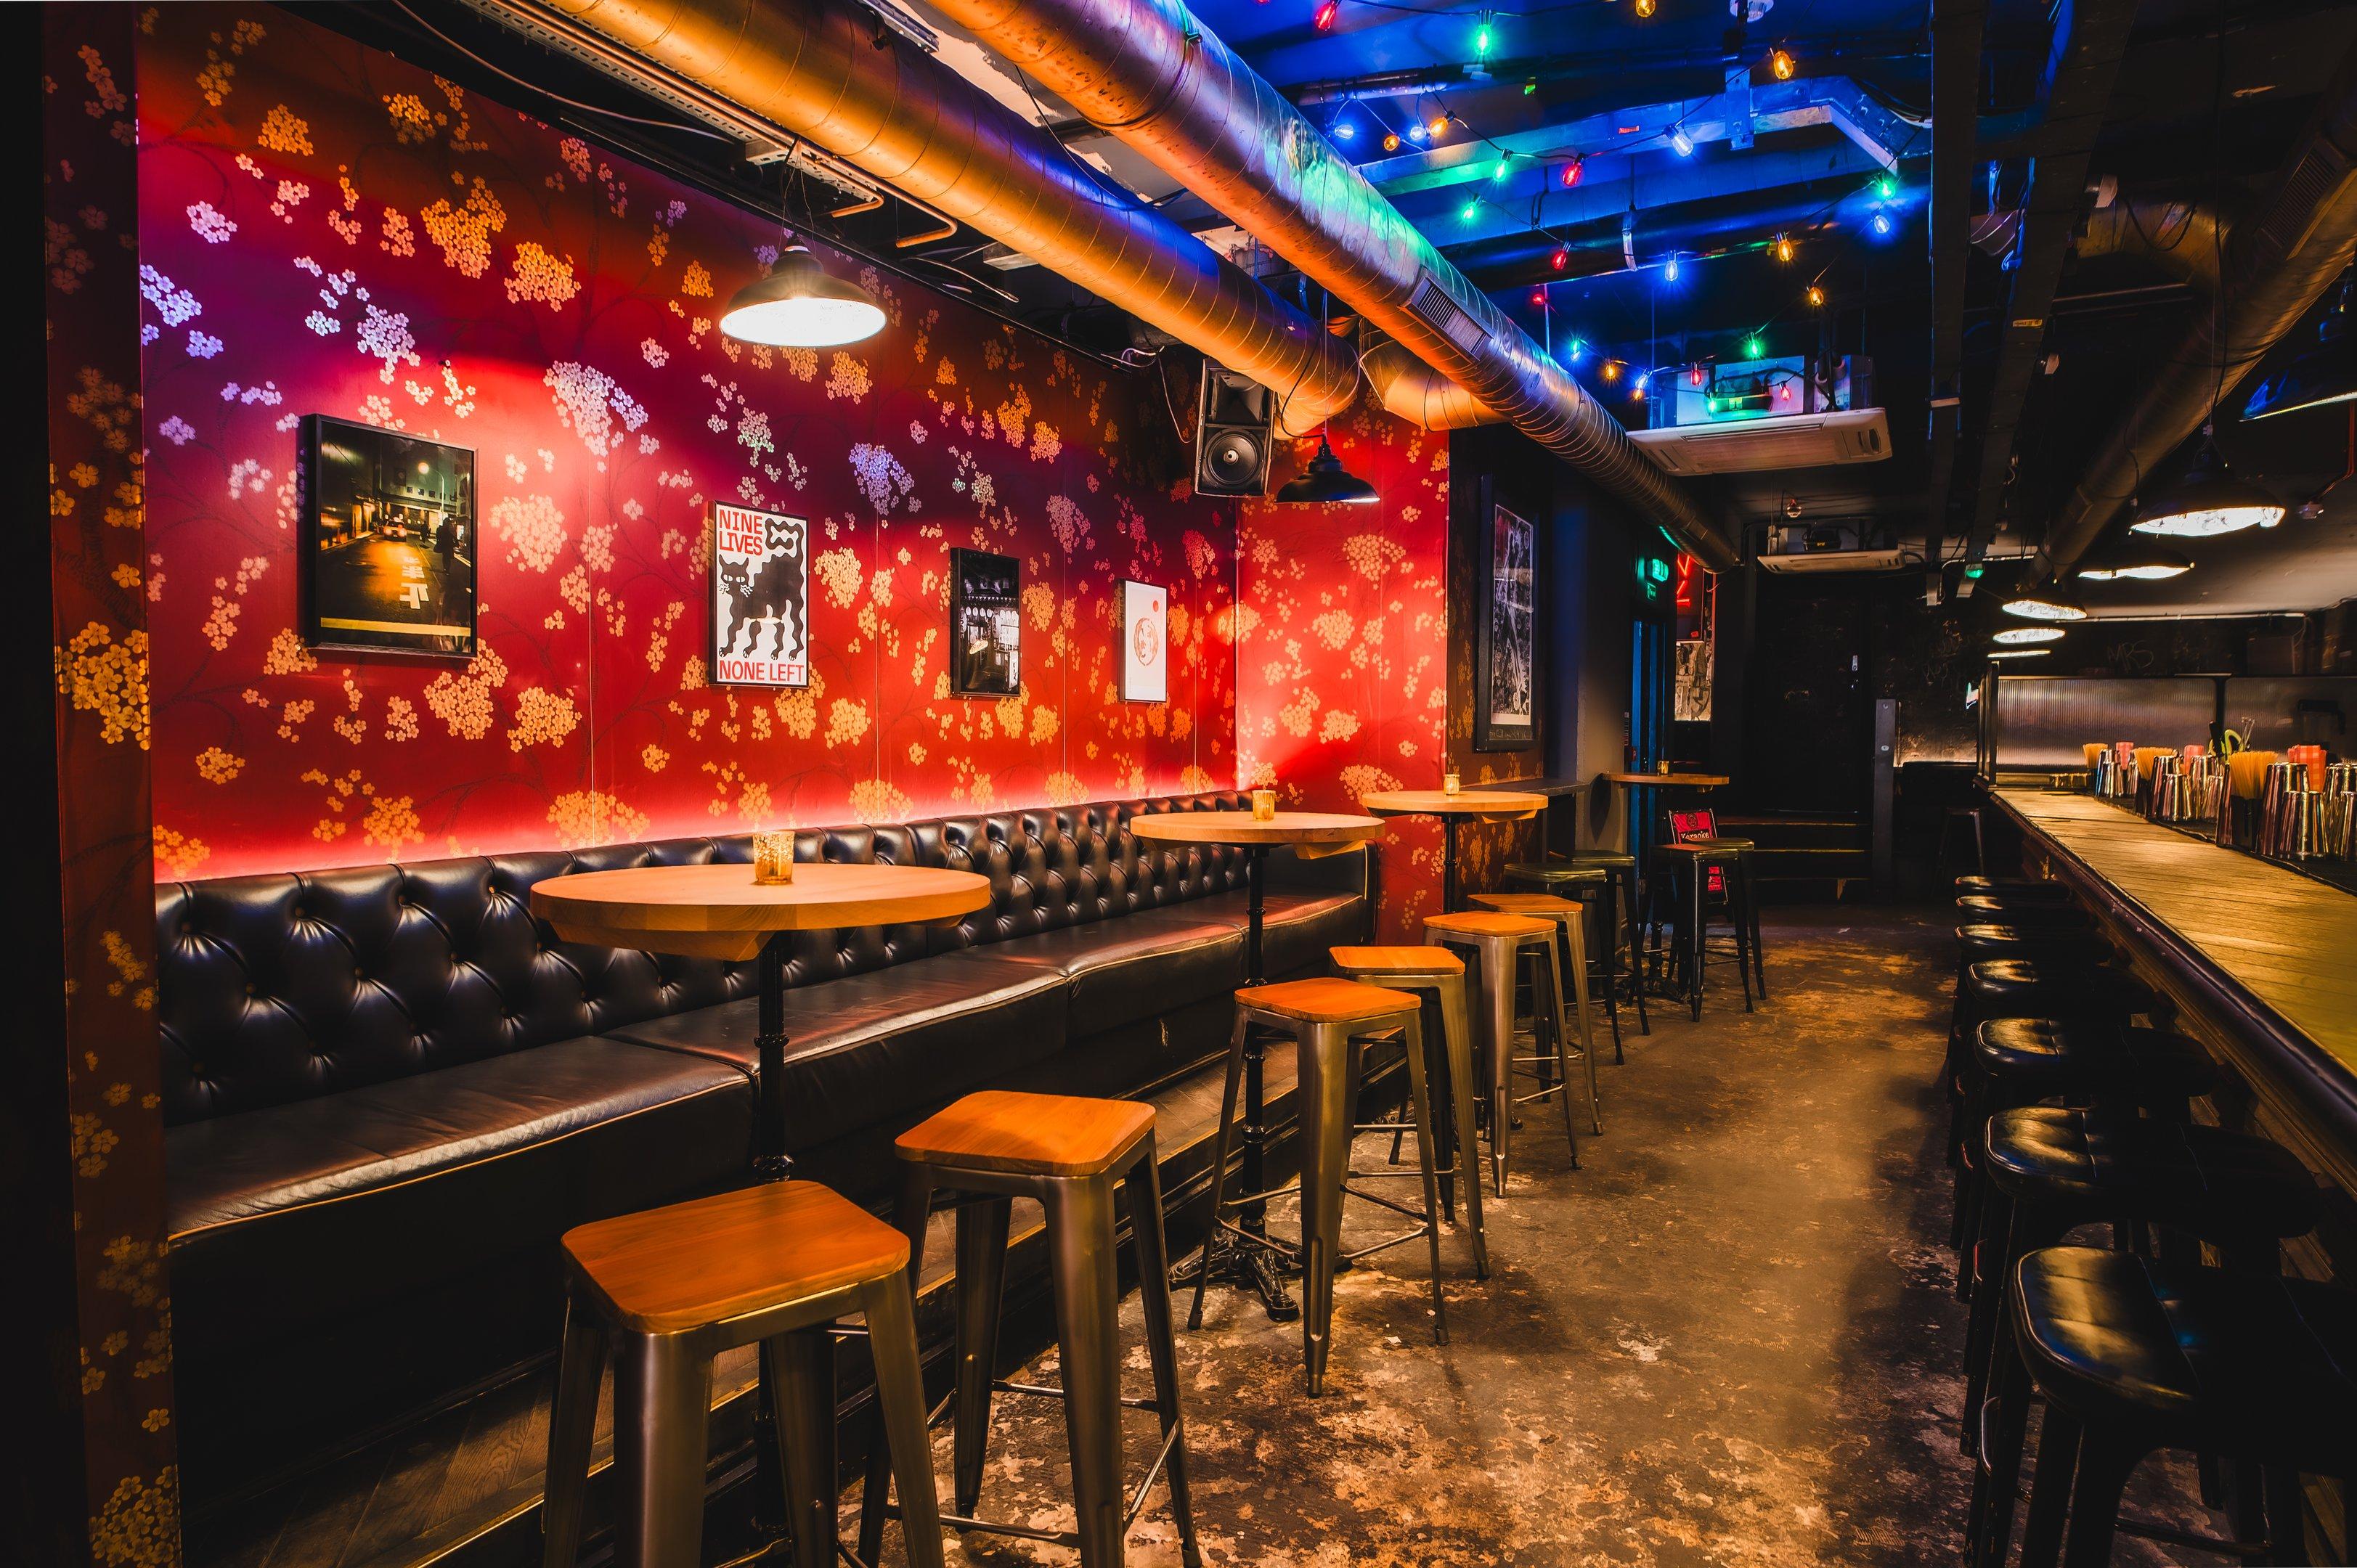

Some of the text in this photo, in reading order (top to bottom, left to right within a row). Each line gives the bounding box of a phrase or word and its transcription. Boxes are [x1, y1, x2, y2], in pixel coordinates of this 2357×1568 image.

[719, 509, 762, 535] NINE
[719, 531, 762, 556] LIVES
[719, 660, 805, 682] NONE LEFT
